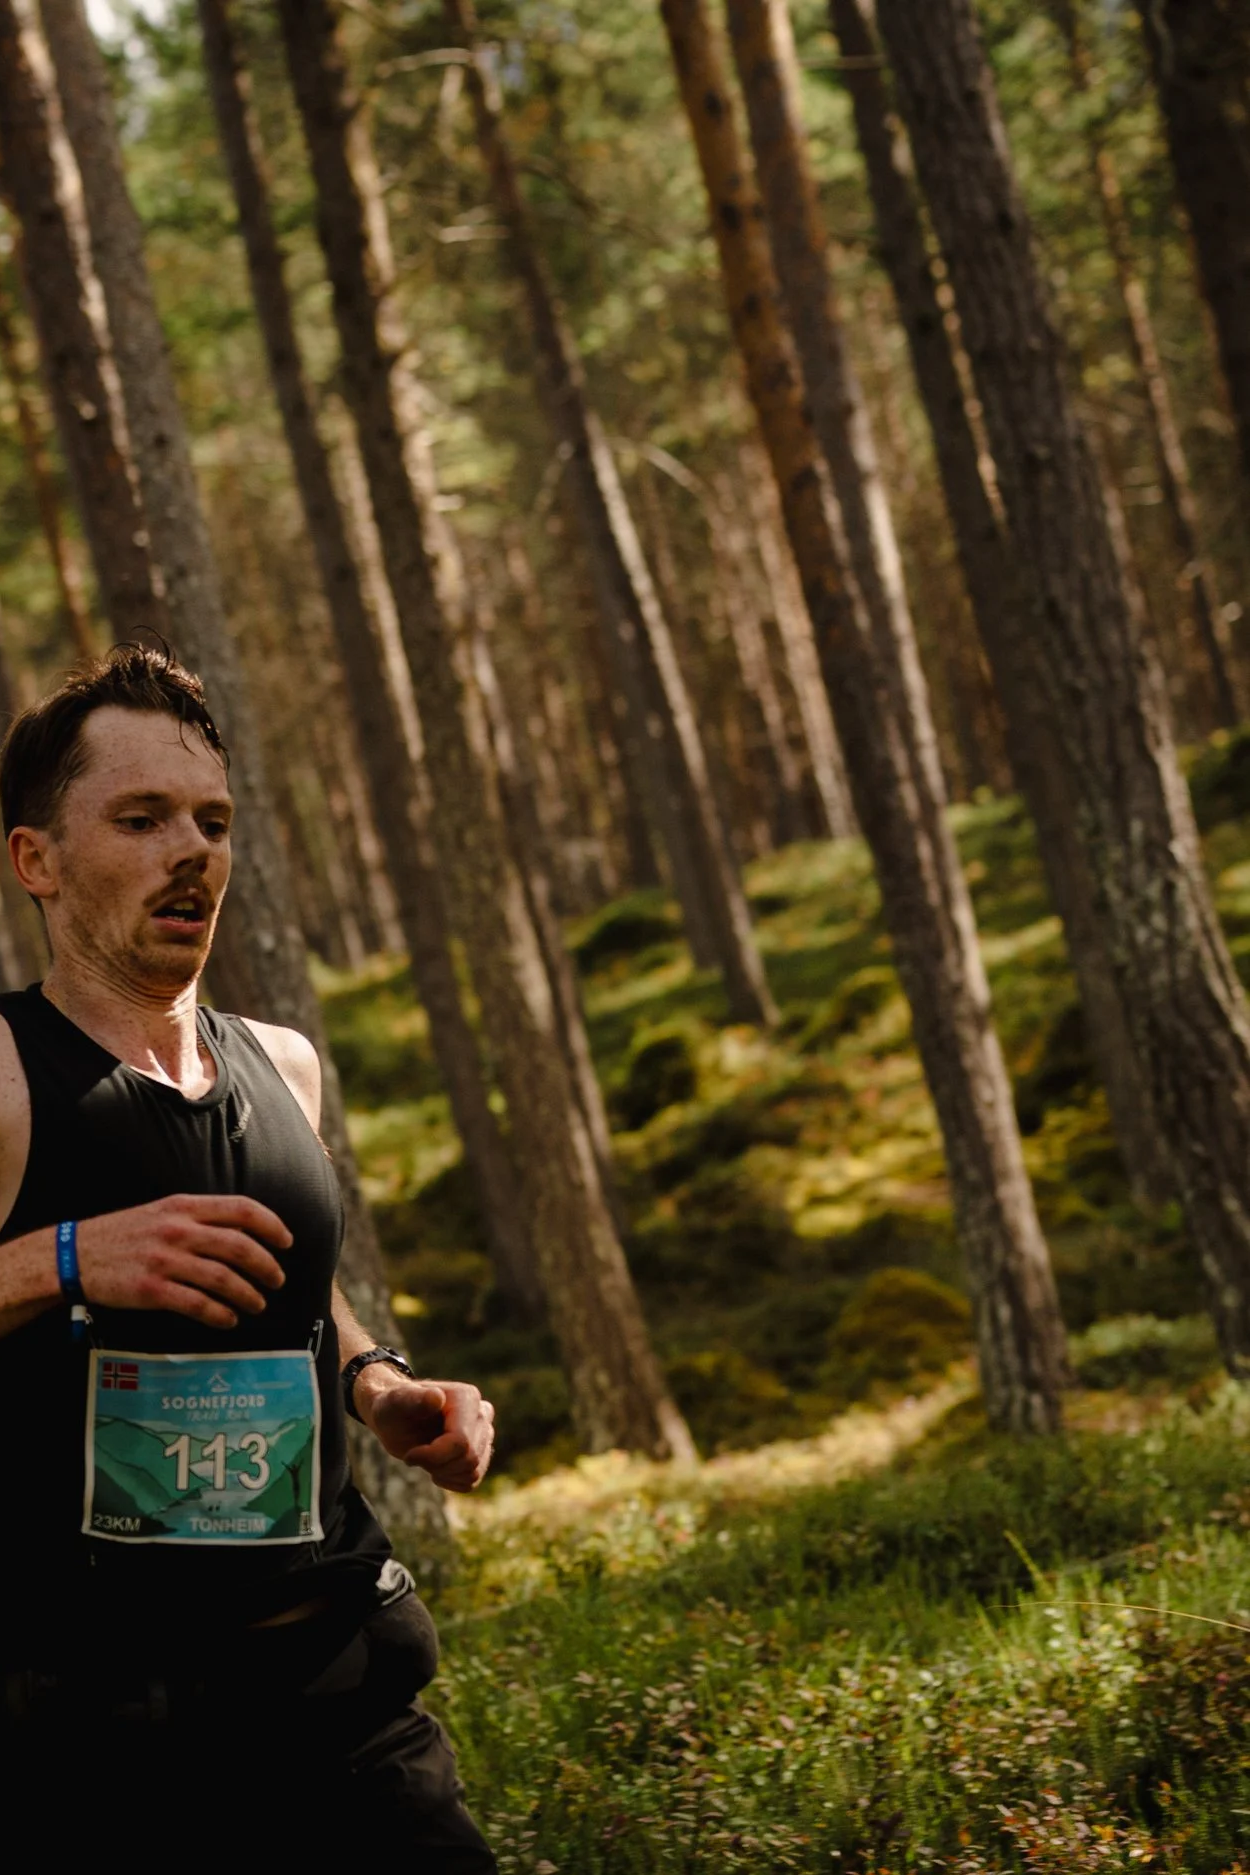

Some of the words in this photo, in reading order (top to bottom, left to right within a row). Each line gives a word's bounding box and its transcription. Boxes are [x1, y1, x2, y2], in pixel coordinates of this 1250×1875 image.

[161, 1394, 265, 1409] SOGNEFJORD
[163, 1431, 271, 1491] 113
[93, 1513, 140, 1531] 23KM
[190, 1517, 265, 1532] TONHEIM
